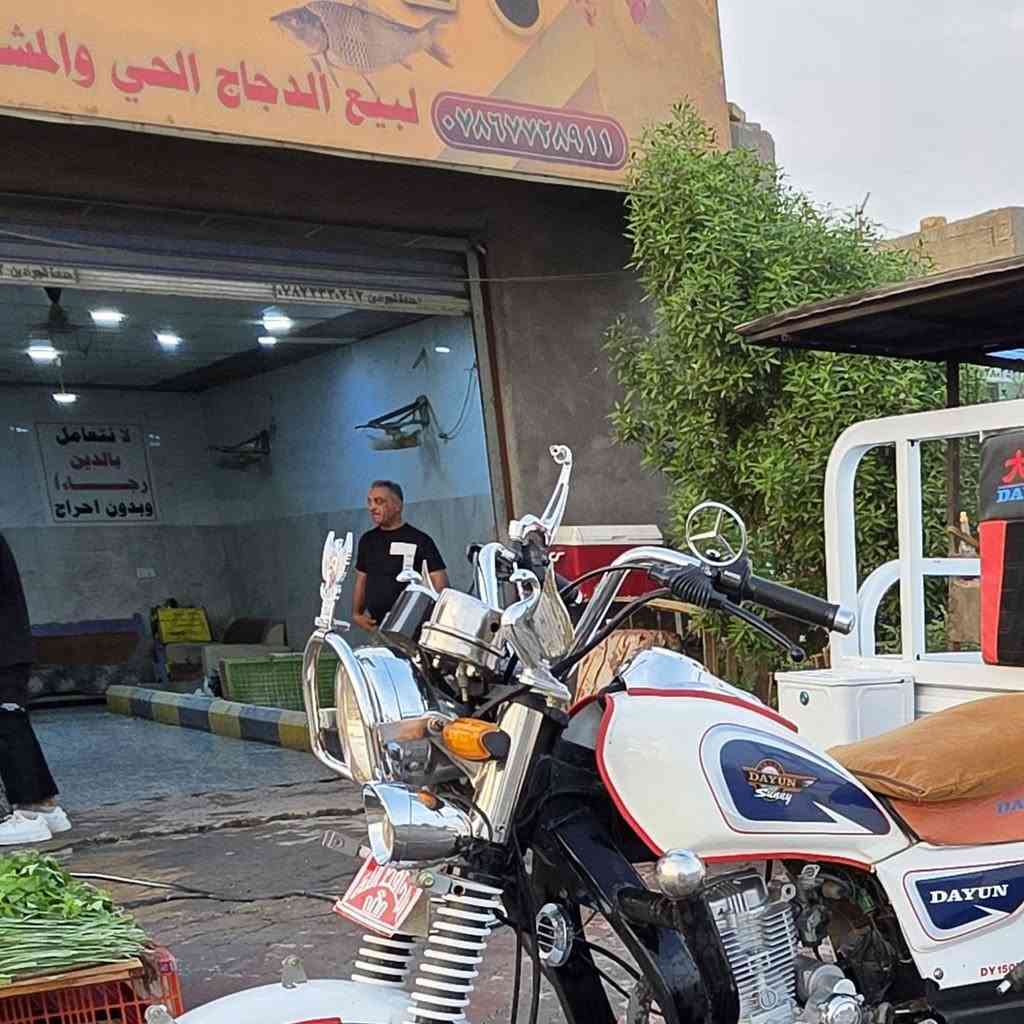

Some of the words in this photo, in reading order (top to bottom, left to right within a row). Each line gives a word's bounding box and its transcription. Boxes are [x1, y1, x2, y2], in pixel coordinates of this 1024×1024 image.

[0, 23, 96, 89] والمش
[110, 50, 200, 103] الحي
[216, 60, 330, 114] الدجاج
[346, 86, 419, 131] لبيع
[70, 452, 121, 472] بالدين
[105, 502, 153, 518] وبدون
[748, 770, 798, 789] DAYUN
[928, 883, 1010, 904] DAYUN
